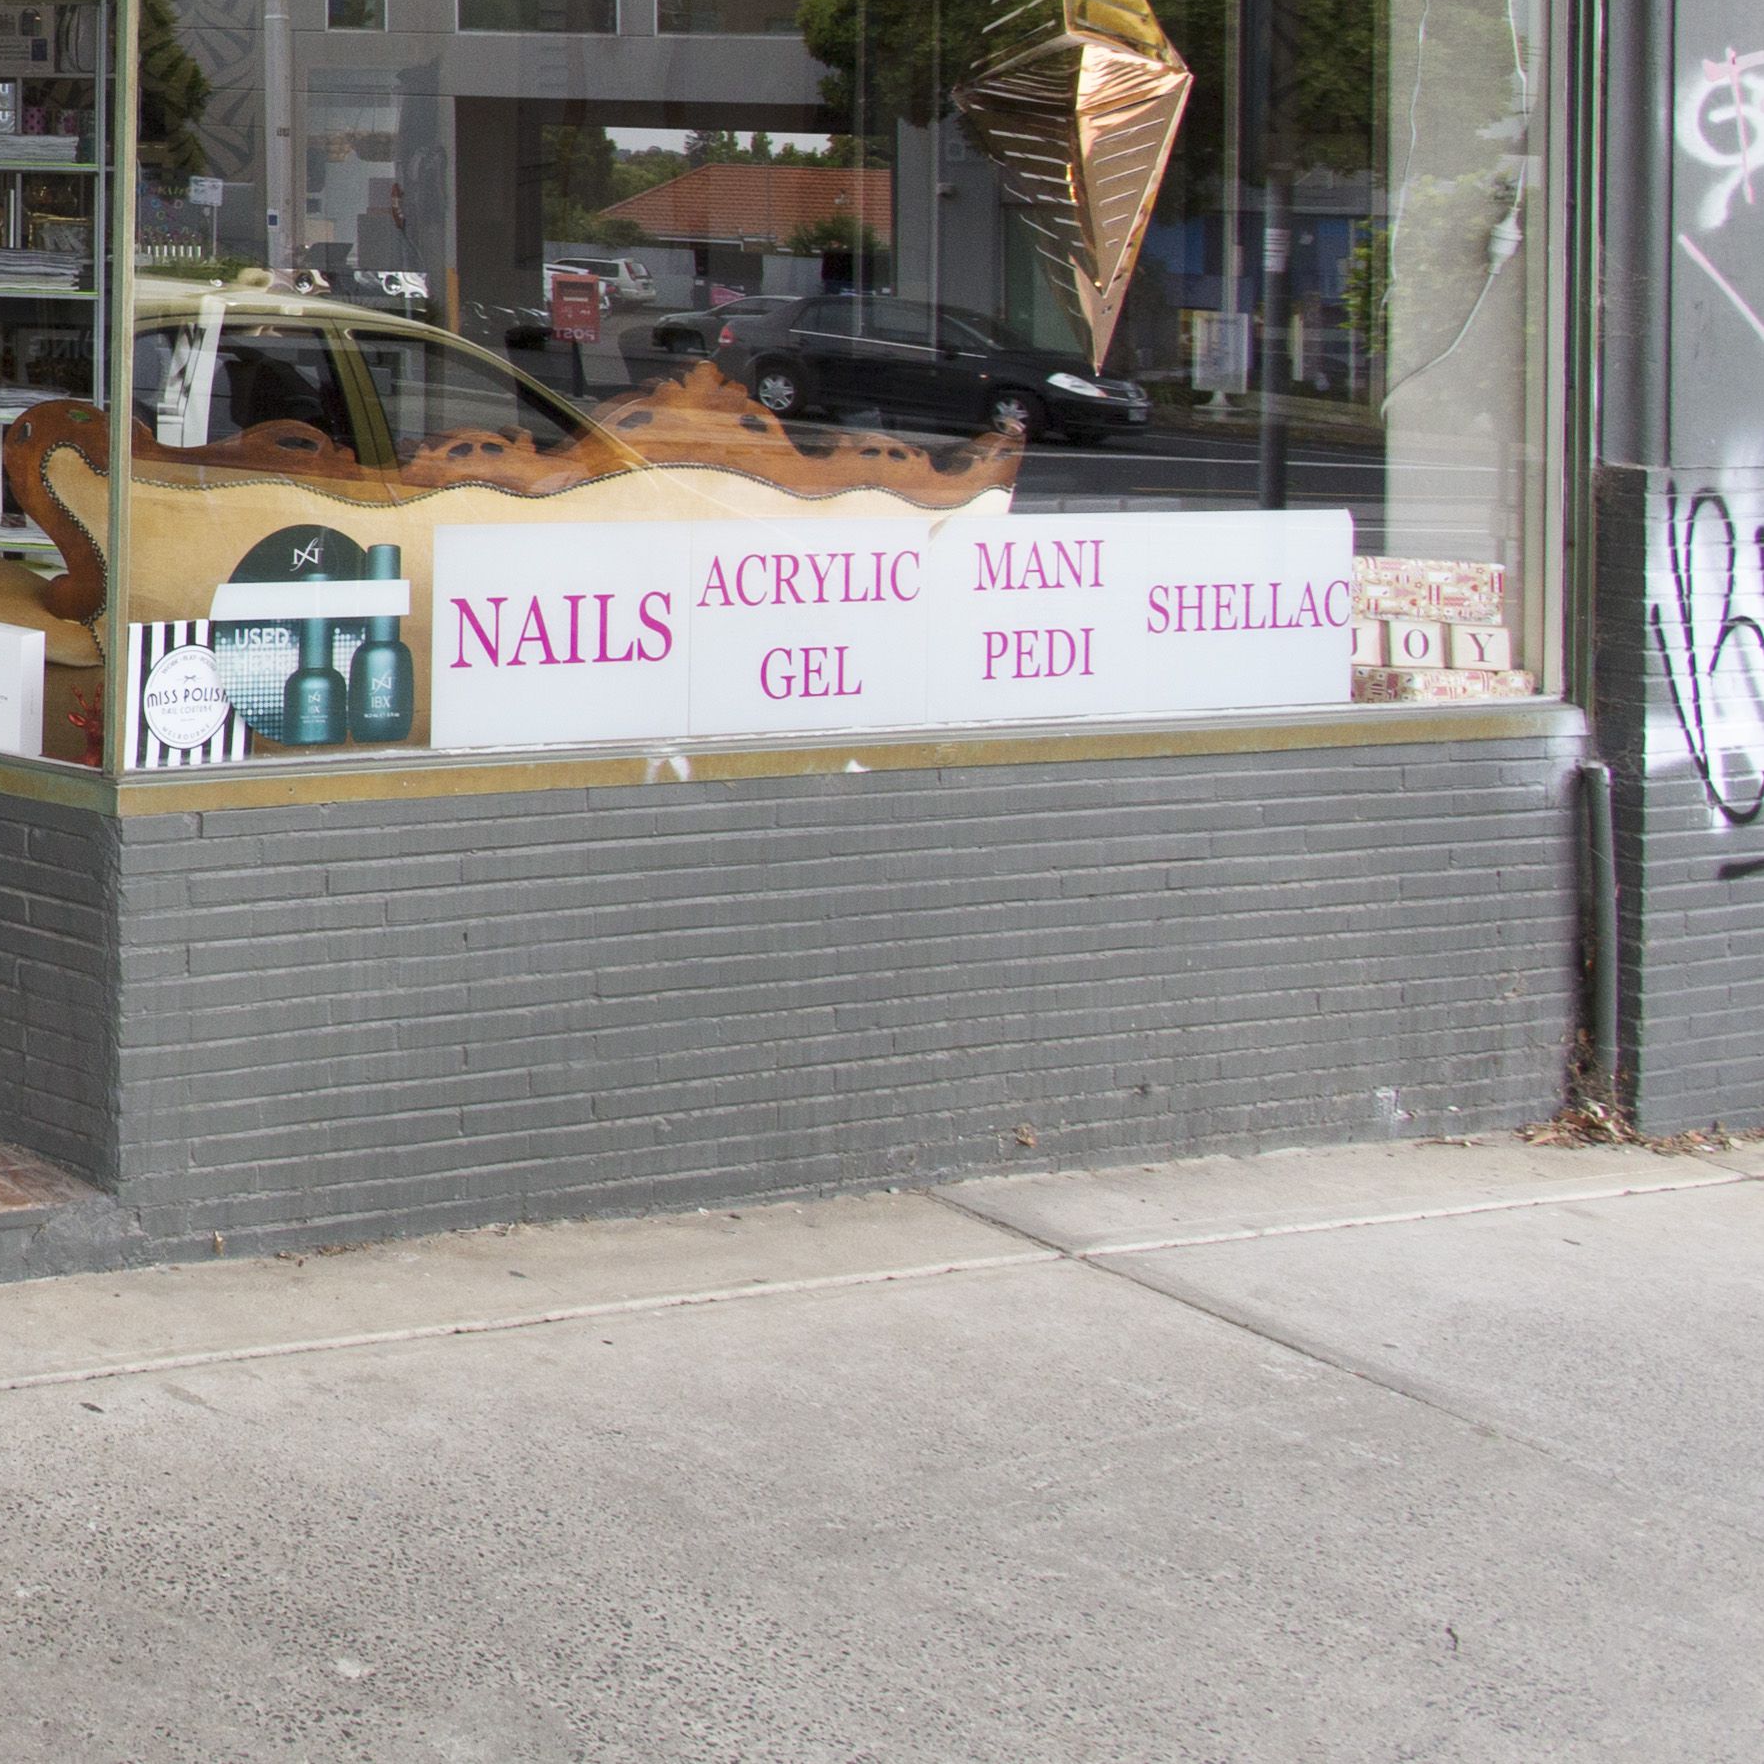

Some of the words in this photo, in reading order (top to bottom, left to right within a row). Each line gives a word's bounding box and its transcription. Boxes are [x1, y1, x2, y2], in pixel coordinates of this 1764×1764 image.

[696, 550, 921, 608] ACRYLIC
[973, 538, 1106, 593] MANI
[449, 590, 673, 670] NAILS
[1147, 579, 1351, 634] SHELLAC
[234, 627, 289, 650] USED
[981, 627, 1095, 681] PEDI
[147, 689, 178, 709] MISS
[759, 645, 863, 700] GEL
[371, 695, 391, 709] IBX
